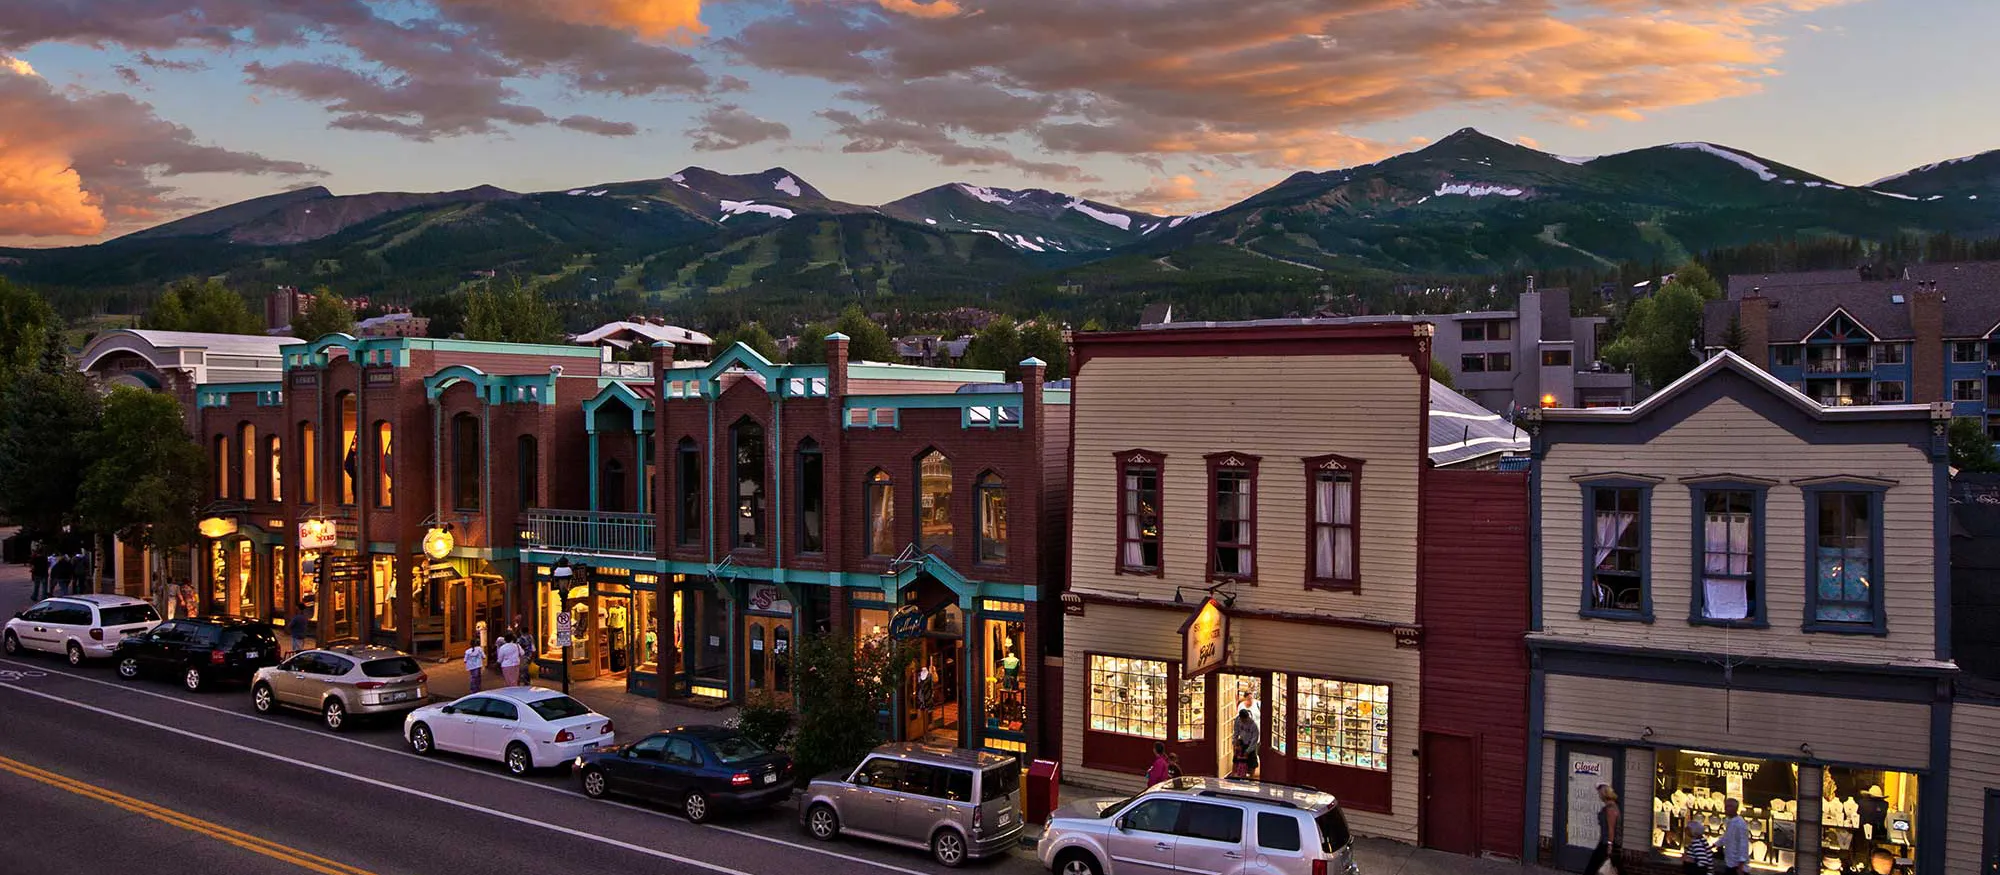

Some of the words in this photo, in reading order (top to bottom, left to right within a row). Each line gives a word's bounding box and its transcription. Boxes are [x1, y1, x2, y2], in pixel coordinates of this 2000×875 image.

[1575, 761, 1600, 772] Closed
[1694, 757, 1710, 767] 30%
[1723, 761, 1740, 770] 60%
[1742, 762, 1760, 773] OFF
[1701, 767, 1715, 775] ALL
[1717, 769, 1753, 780] JEWELRY
